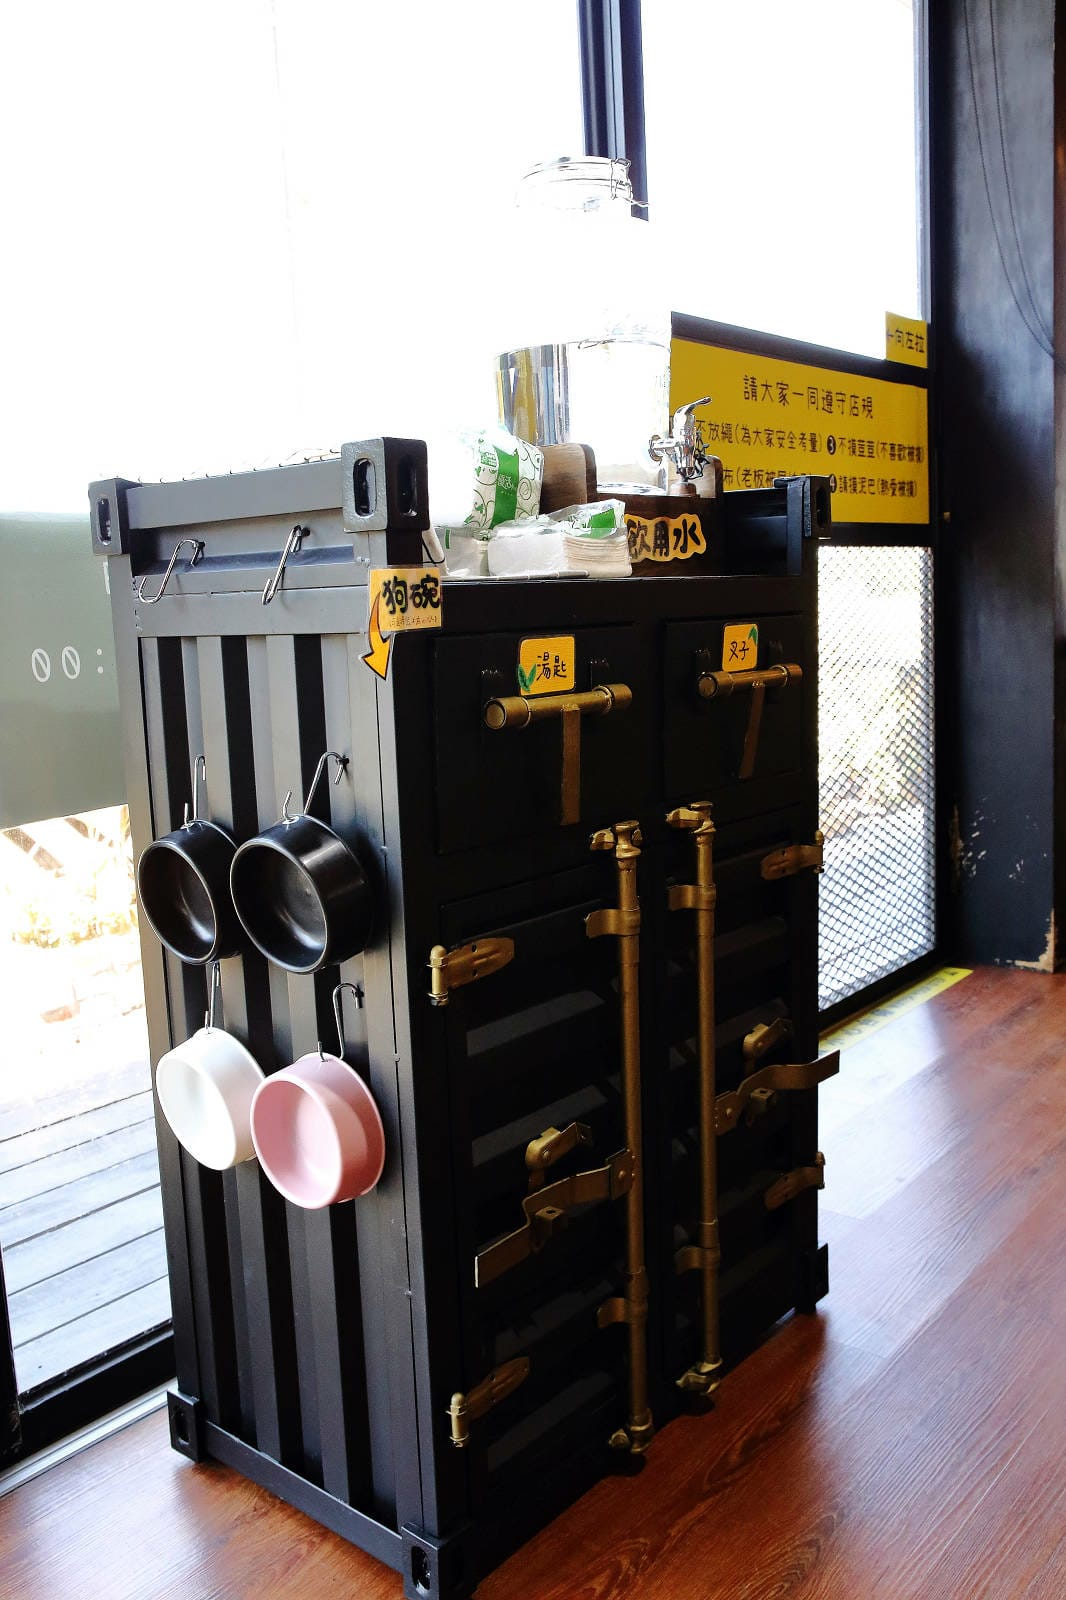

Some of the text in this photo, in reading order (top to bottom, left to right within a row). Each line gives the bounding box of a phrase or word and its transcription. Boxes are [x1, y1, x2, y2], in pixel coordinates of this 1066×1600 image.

[742, 374, 874, 419] 請大家一同遵守店規
[626, 518, 702, 559] 飲用水
[382, 573, 440, 615] 狗碗
[536, 651, 568, 681] 湯匙
[728, 640, 750, 662] 叉子
